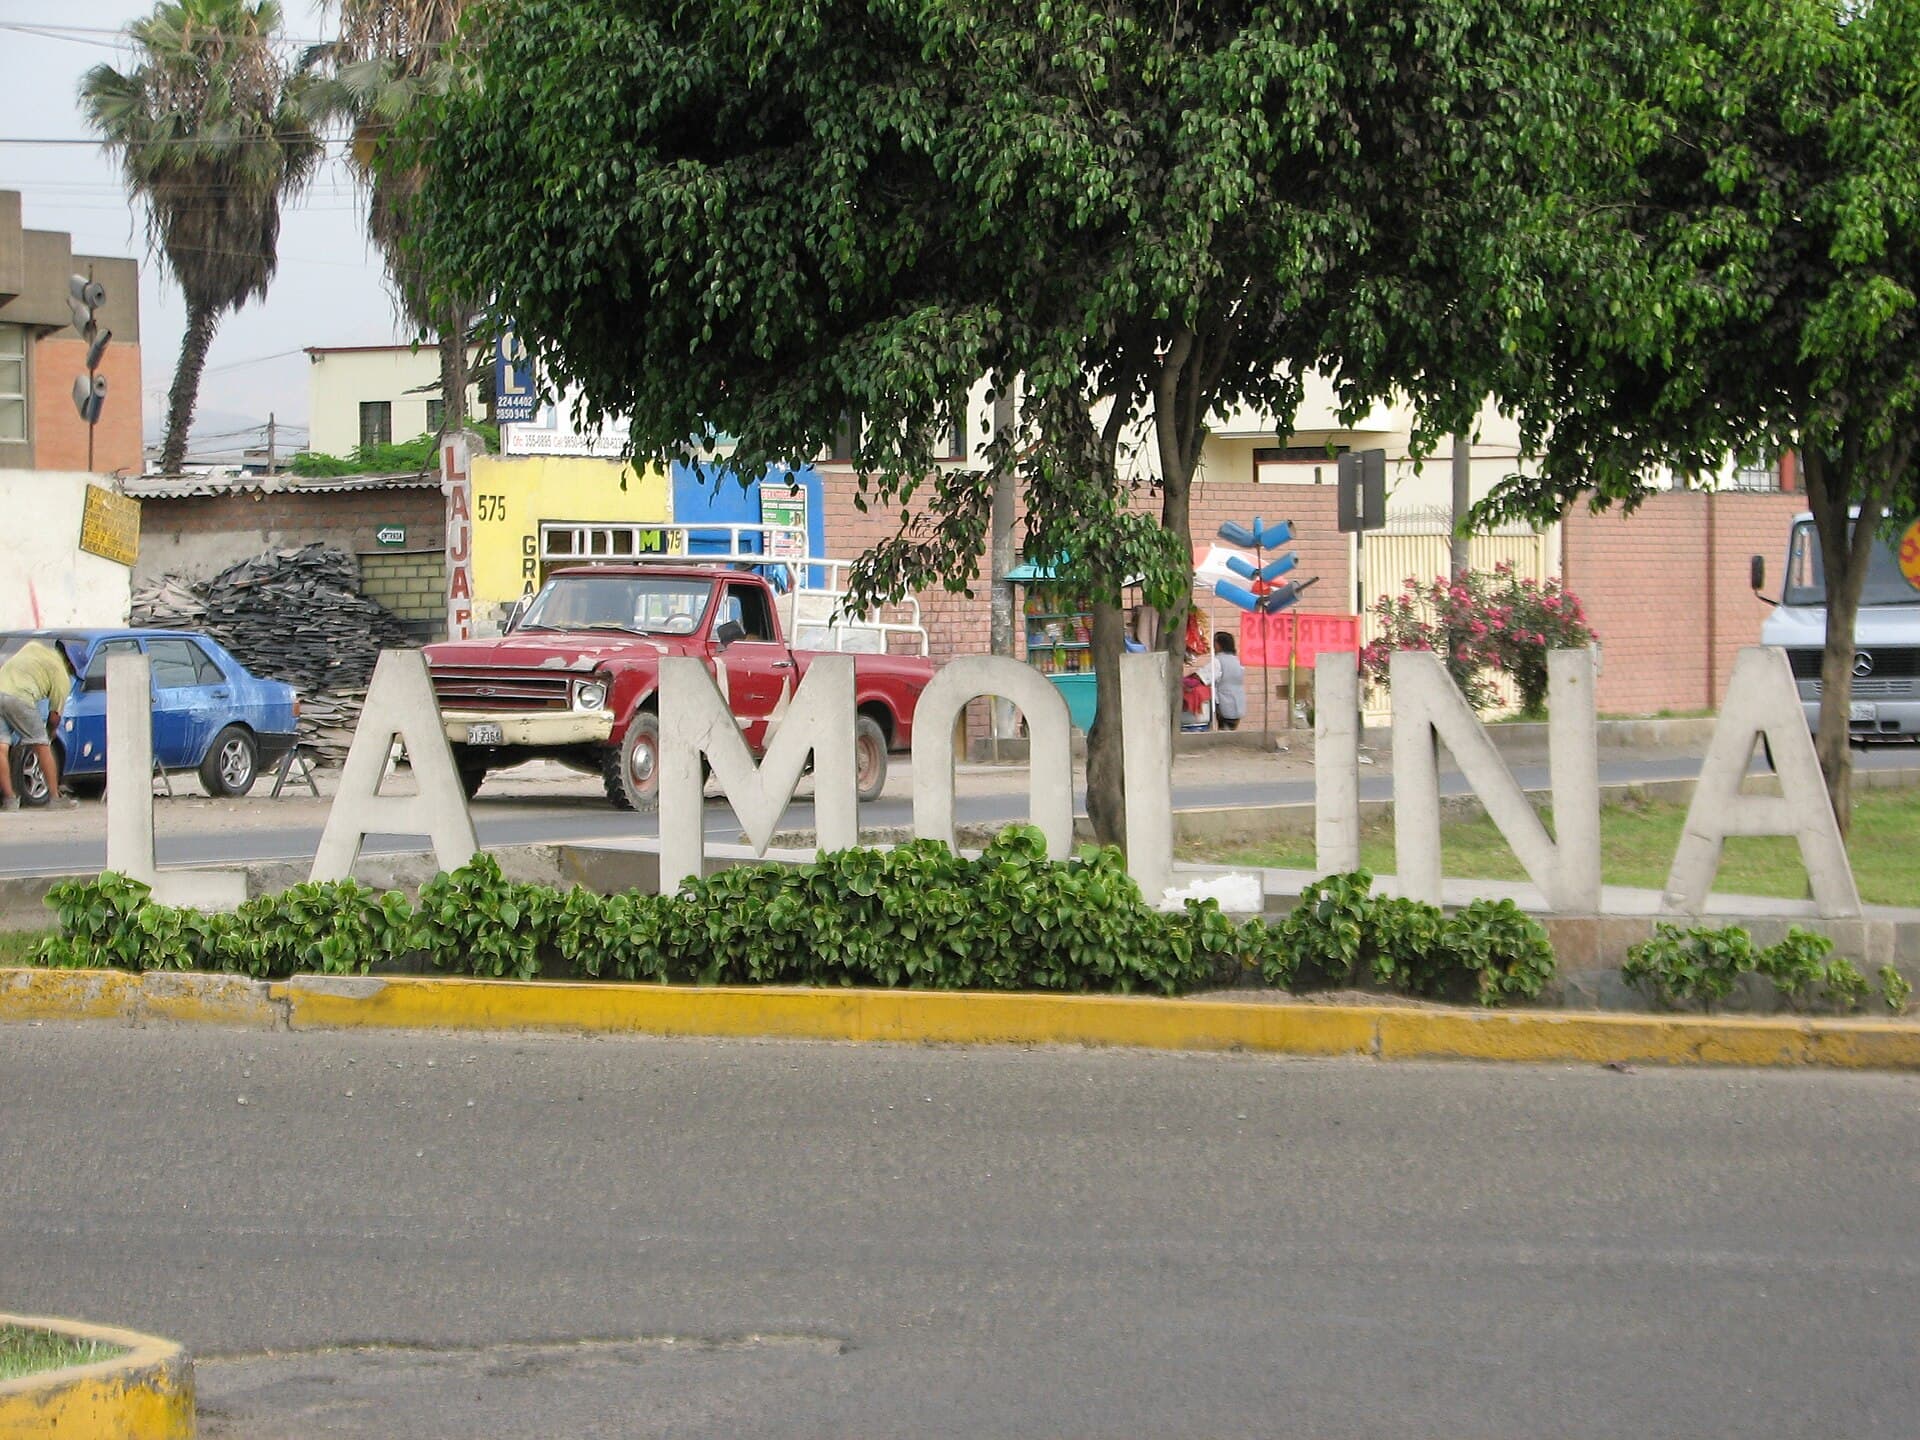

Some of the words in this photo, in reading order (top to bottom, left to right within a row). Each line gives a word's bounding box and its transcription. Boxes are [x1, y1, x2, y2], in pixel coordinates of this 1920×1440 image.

[478, 495, 506, 522] 575
[106, 649, 481, 915] LA
[658, 646, 1863, 919] MOLINA
